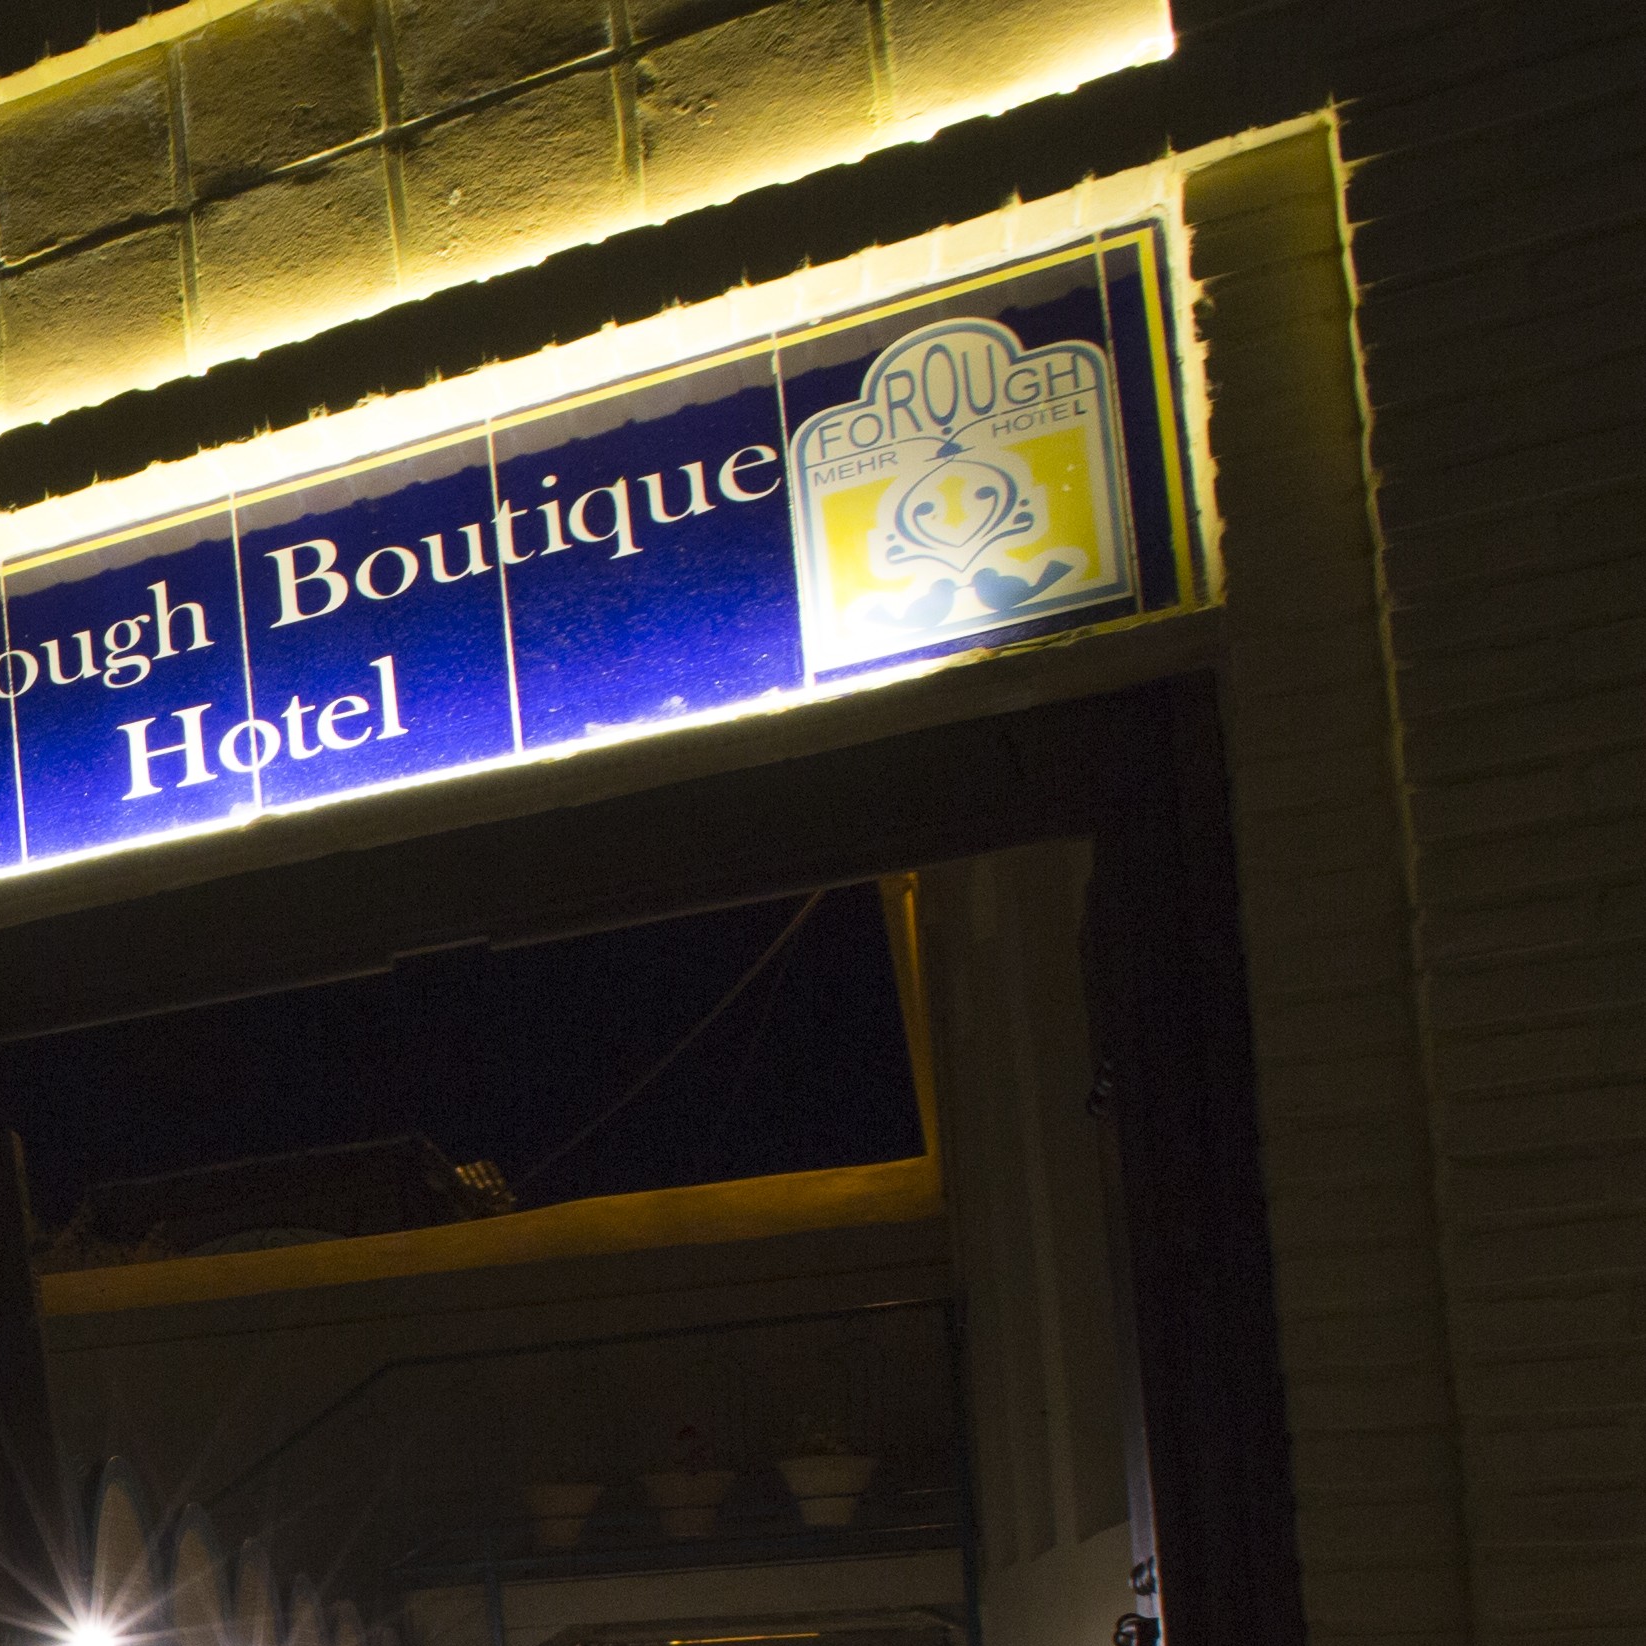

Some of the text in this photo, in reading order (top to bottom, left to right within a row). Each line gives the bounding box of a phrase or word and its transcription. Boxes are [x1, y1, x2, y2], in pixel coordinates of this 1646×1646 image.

[814, 399, 1088, 487] MEHR HOTEL
[817, 344, 1083, 460] FOROUGH
[263, 444, 783, 629] Boutique
[116, 655, 410, 801] Hotel
